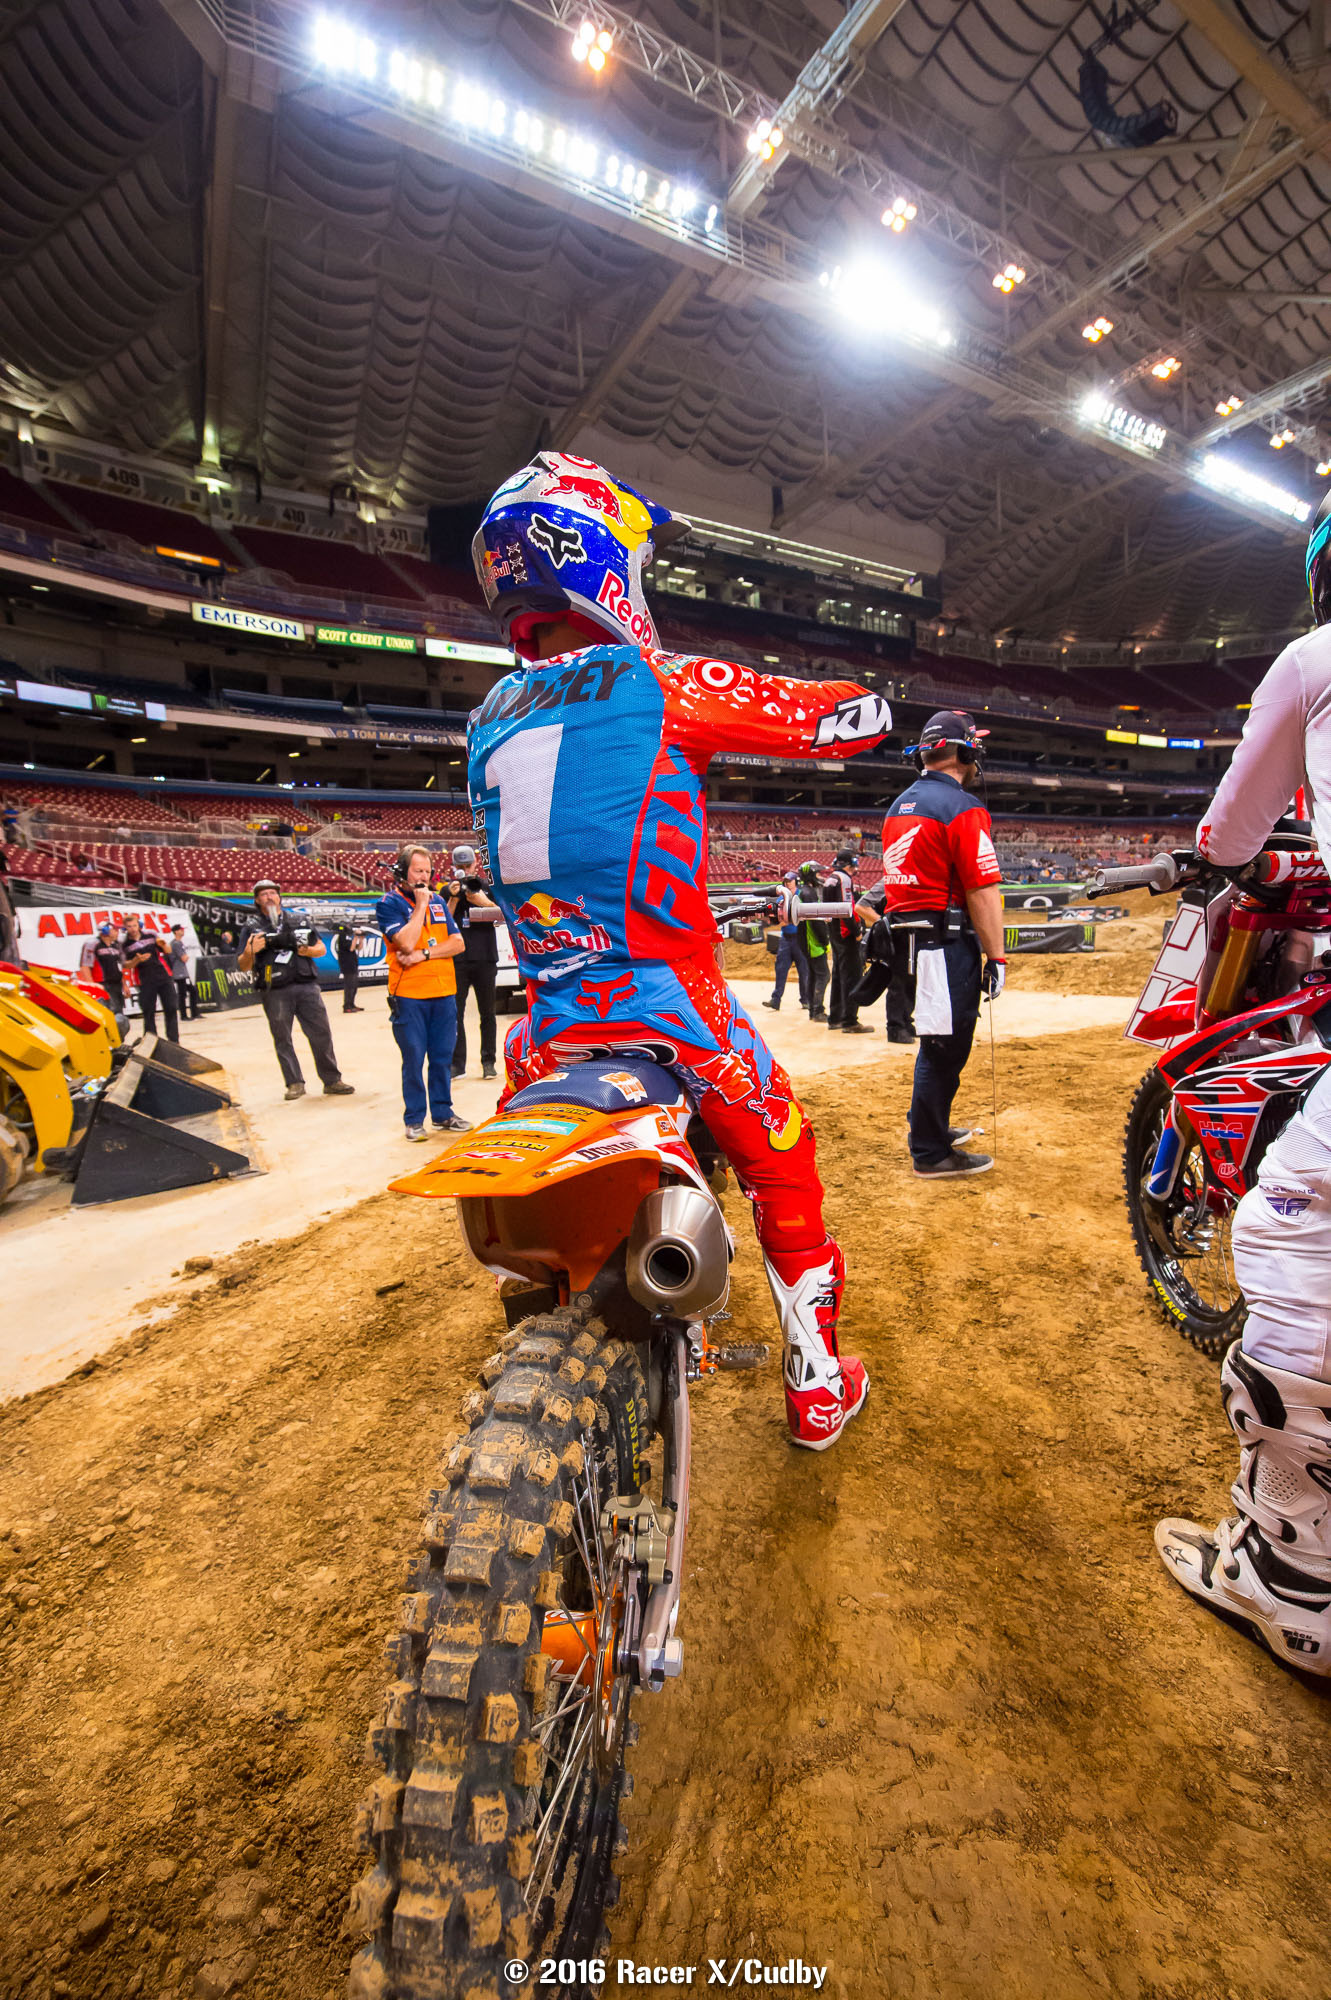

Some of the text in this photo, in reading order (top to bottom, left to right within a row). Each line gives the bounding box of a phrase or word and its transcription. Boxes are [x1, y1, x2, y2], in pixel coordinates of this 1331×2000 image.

[107, 466, 140, 487] 409
[200, 607, 298, 636] EMERSON
[317, 628, 415, 650] SCOTT CREDIT UNION
[352, 729, 377, 740] TOM
[379, 732, 410, 742] MACK
[484, 722, 565, 885] 1
[1199, 1120, 1245, 1139] HRC
[1152, 1278, 1188, 1321] DUNLOP
